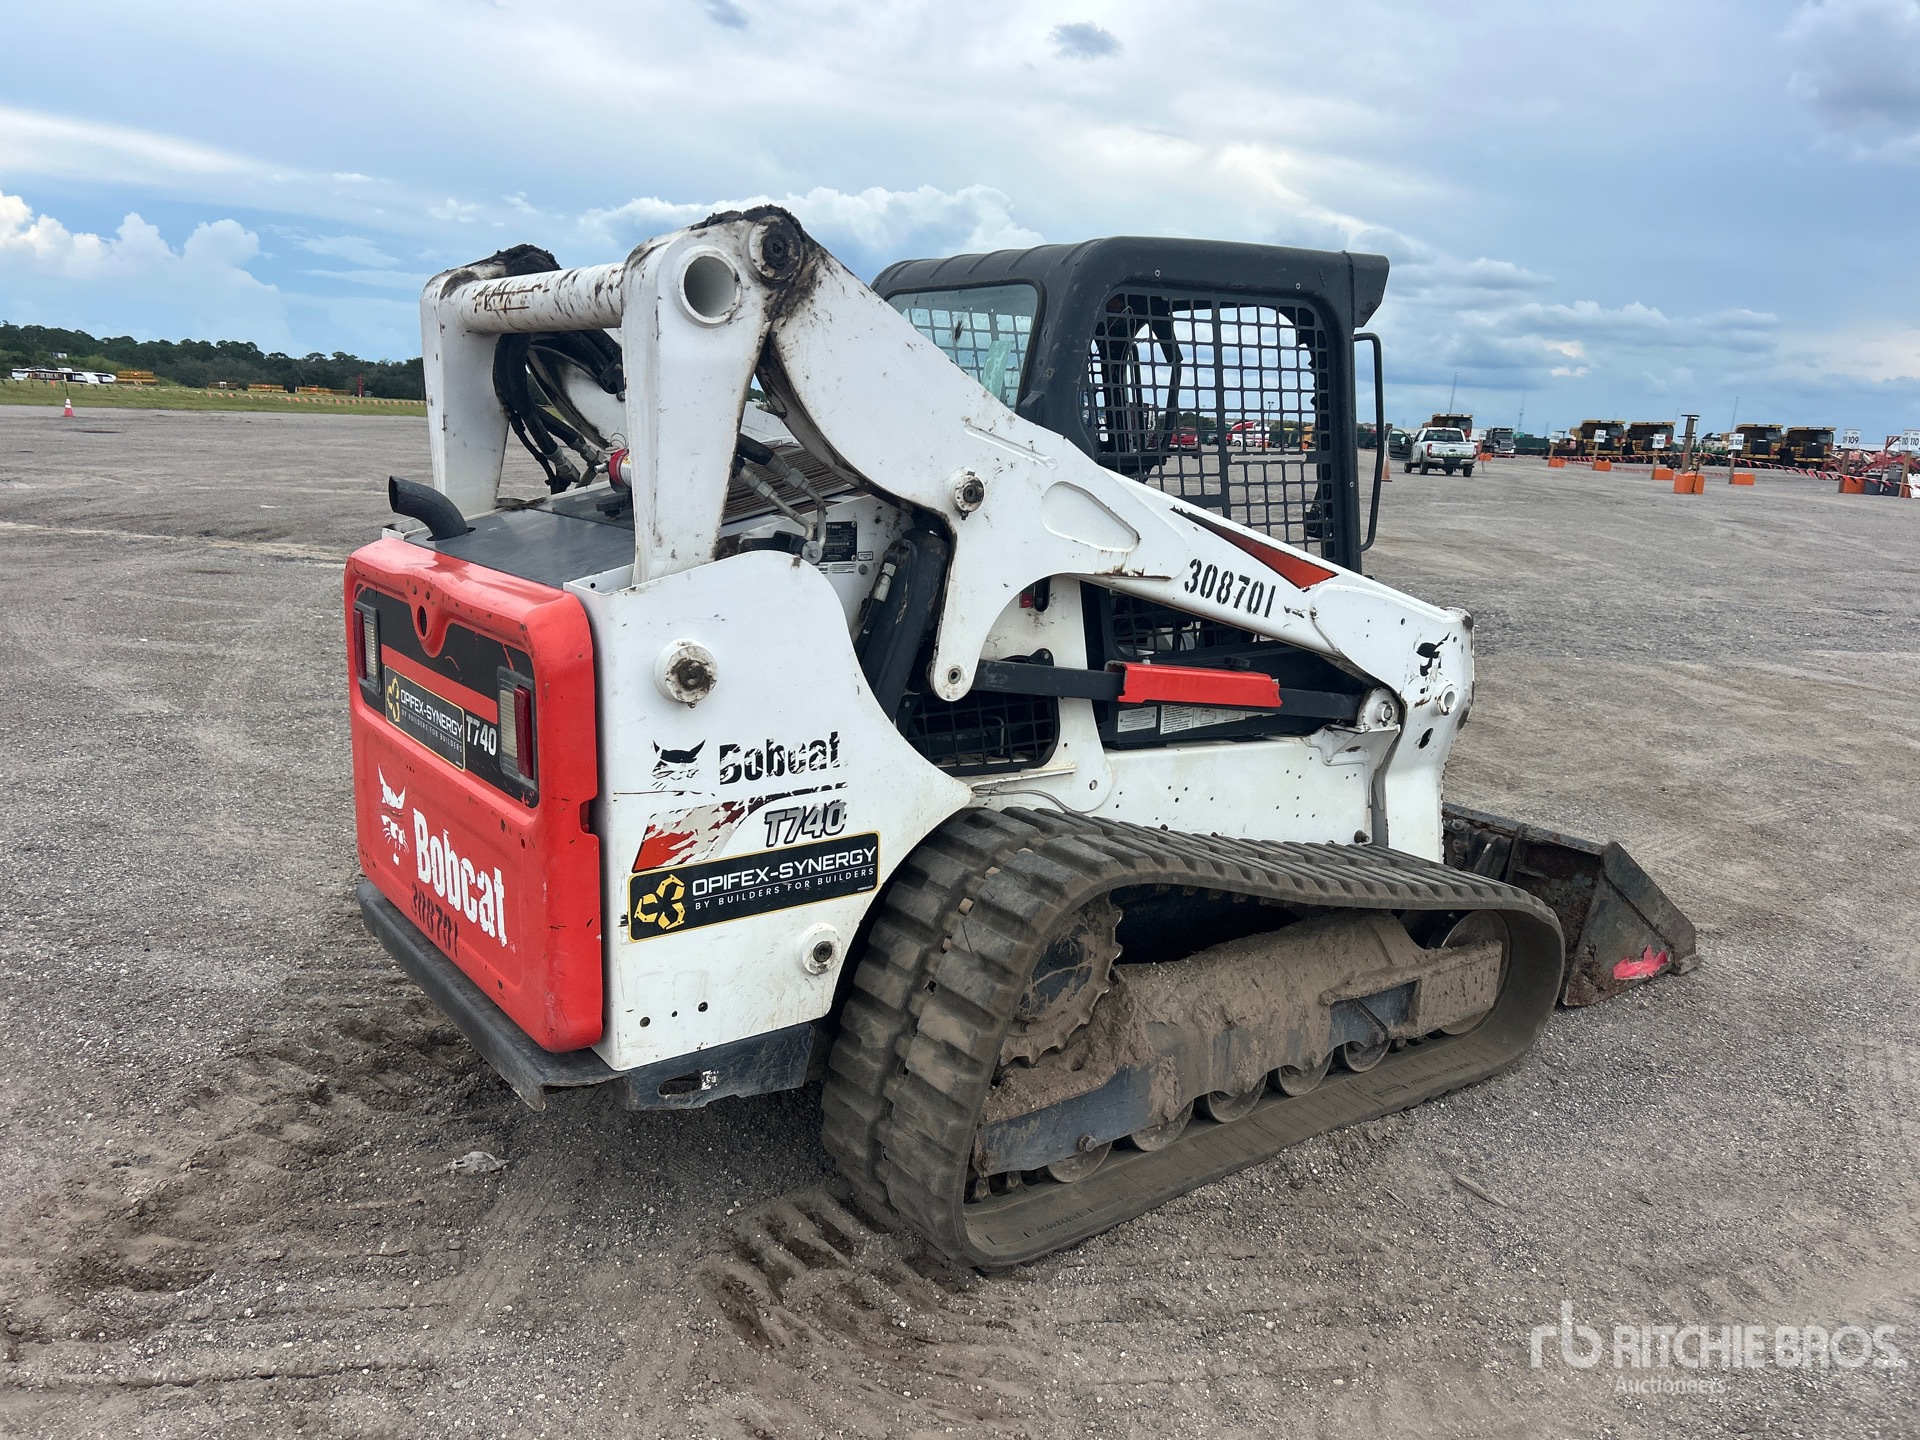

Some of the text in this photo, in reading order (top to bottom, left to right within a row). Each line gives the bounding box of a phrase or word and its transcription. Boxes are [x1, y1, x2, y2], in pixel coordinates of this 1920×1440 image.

[1184, 558, 1277, 618] 308701
[400, 689, 463, 738] OPIFEX-SYNERGY
[401, 708, 463, 753] BY BUILDERS FOR BUILDERS
[465, 714, 497, 756] T740
[719, 731, 841, 785] Bobcat
[764, 799, 848, 848] T740
[413, 807, 508, 948] Bobcat
[692, 846, 877, 896] OPIFEX-SYNERGY
[695, 867, 875, 911] BY BUILDERS FOR BUILDERS
